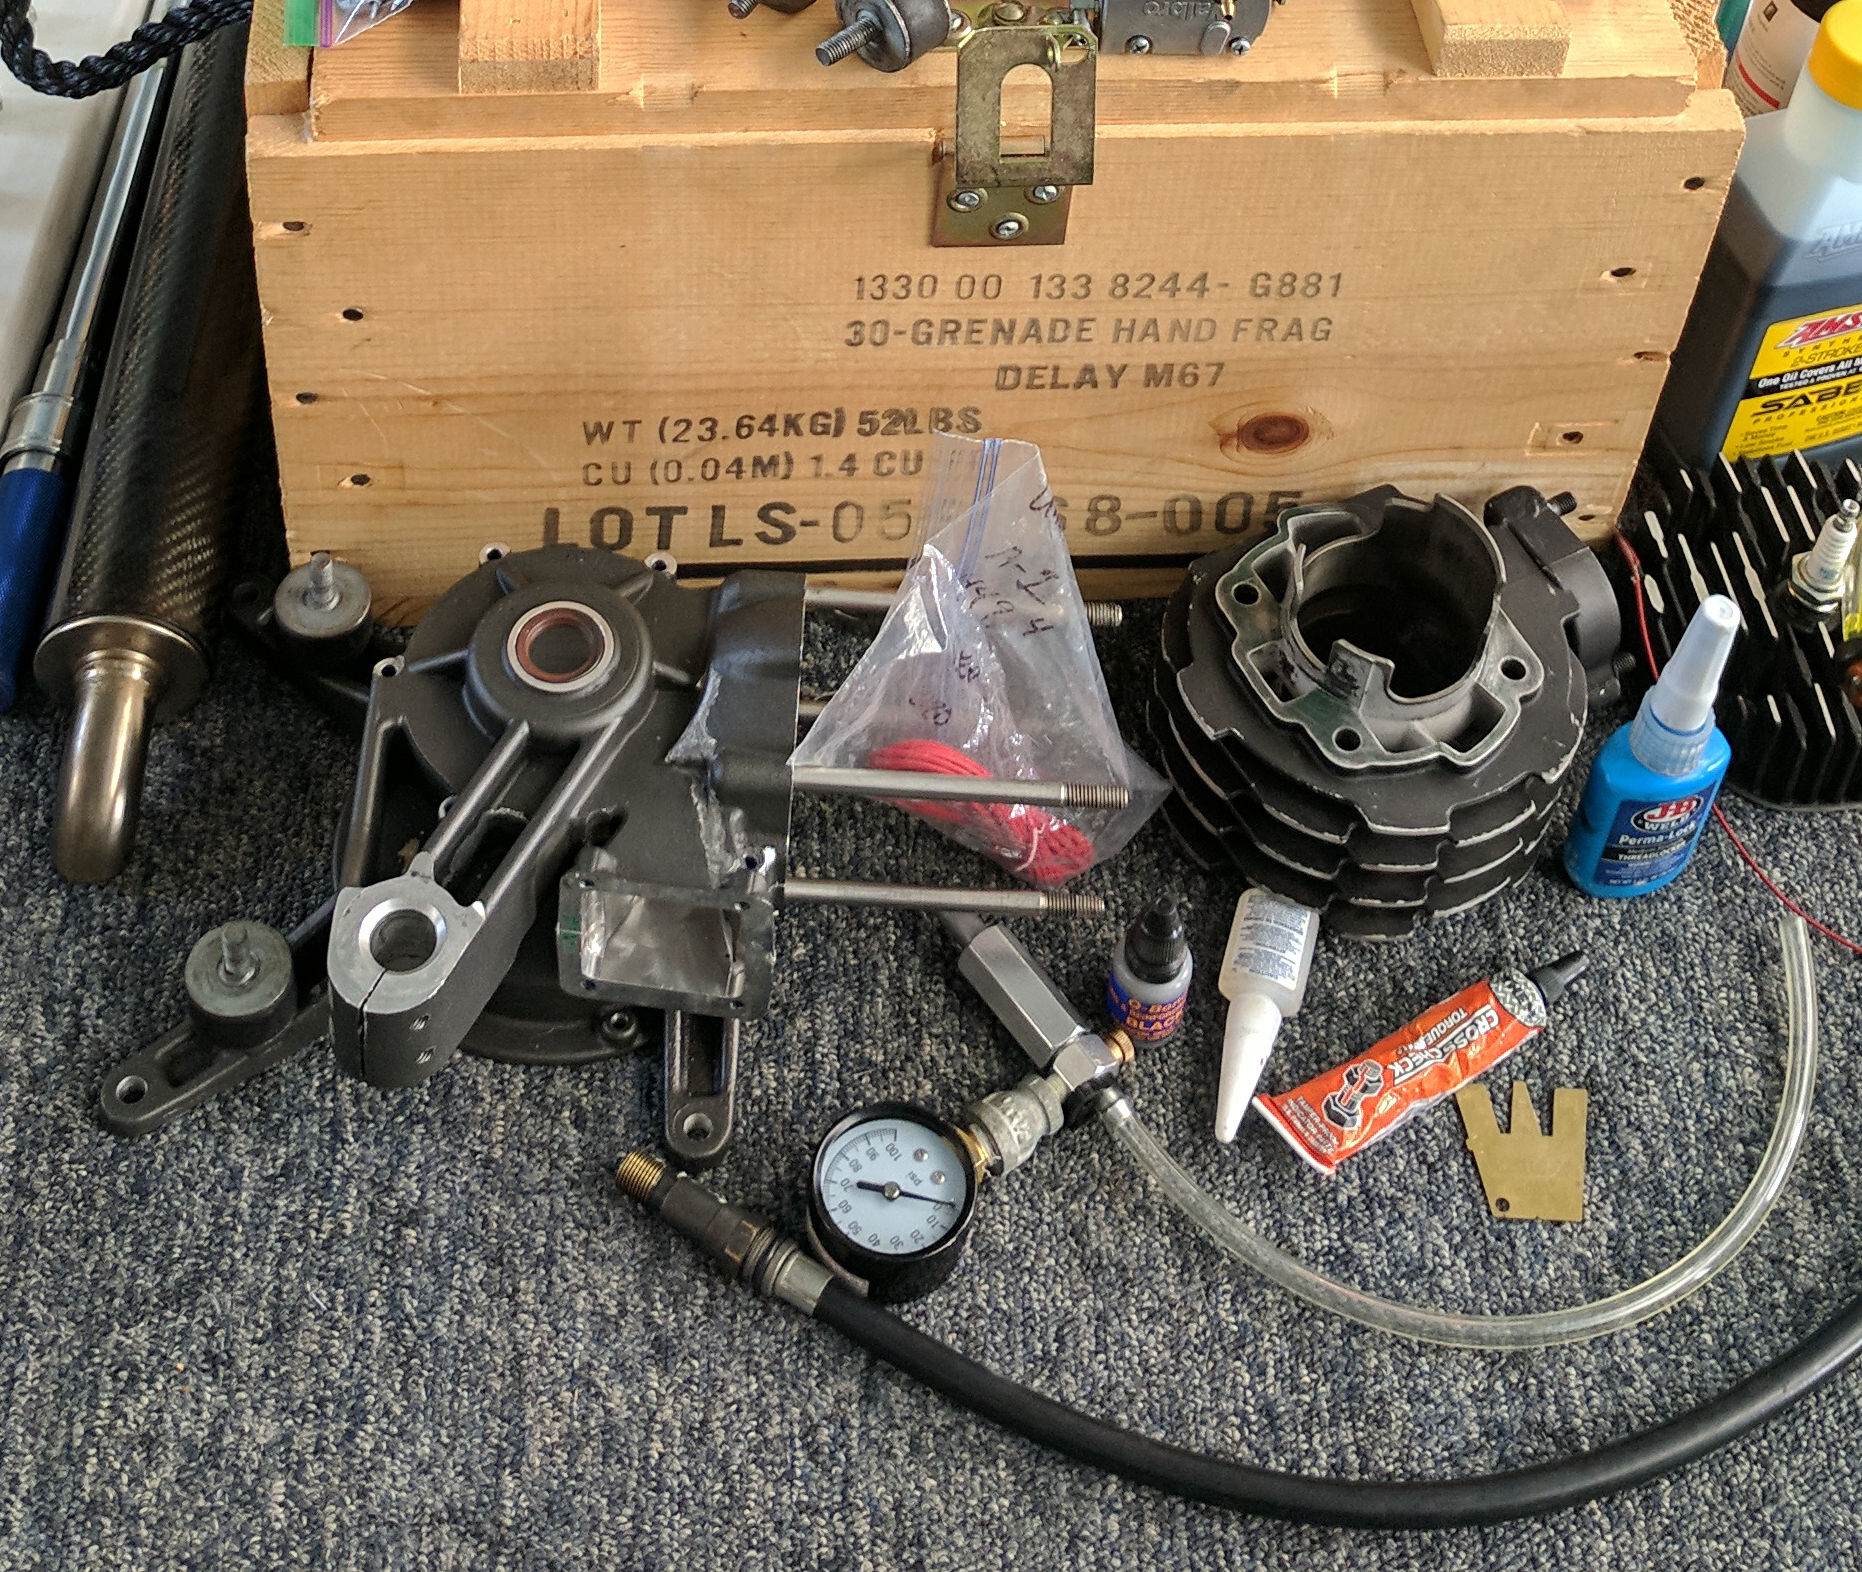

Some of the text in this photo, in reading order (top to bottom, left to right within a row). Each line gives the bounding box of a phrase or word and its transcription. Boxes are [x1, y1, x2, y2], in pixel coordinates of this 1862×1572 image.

[854, 271, 1344, 301] 1330 00 133 8244- G881
[843, 316, 1333, 347] 30-GRENADE HAND FRAG
[994, 361, 1225, 392] DELAY M67
[1758, 376, 1780, 389] One
[1784, 371, 1798, 382] Oil
[1799, 364, 1836, 380] Covers
[1837, 359, 1851, 371] All
[582, 419, 644, 446] WT
[657, 408, 848, 445] (23.64KG)
[581, 462, 633, 487] CU
[649, 452, 796, 486] (0.04M)
[810, 453, 860, 479] 1.4
[873, 450, 925, 476] CU
[542, 504, 689, 553] LOT
[1618, 820, 1697, 846] Perma-Lock
[865, 1146, 880, 1161] 90
[885, 1141, 903, 1162] 100
[848, 1158, 863, 1173] 80
[907, 1170, 923, 1187] psi
[838, 1199, 853, 1214] 60
[847, 1220, 863, 1236] 50
[909, 1229, 925, 1245] 20
[867, 1233, 882, 1248] 40
[889, 1234, 905, 1251] 30
